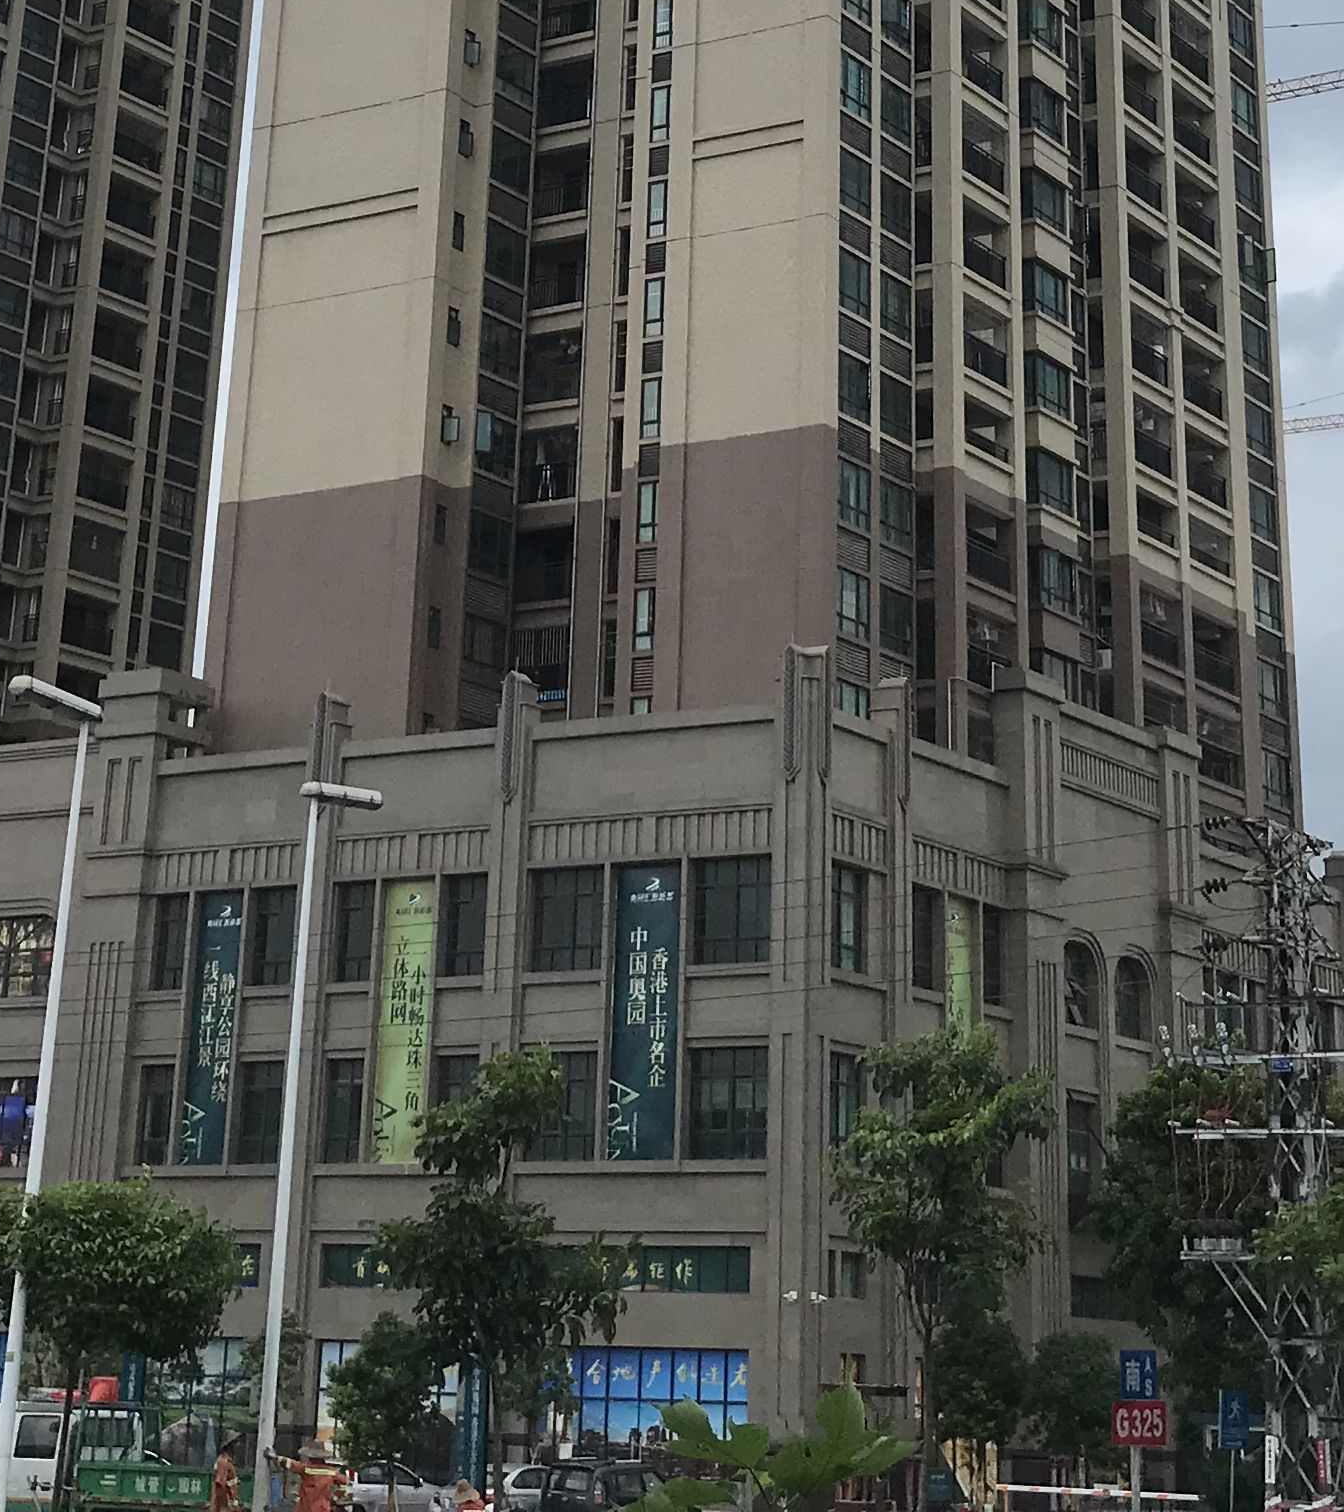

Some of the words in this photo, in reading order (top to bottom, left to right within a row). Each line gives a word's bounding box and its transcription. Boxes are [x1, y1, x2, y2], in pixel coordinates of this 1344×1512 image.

[390, 936, 410, 1024] 立体路网
[627, 926, 648, 1025] 中国奥园
[647, 947, 669, 1088] 香港上市名企
[210, 972, 235, 1102] 静享公园环绕
[405, 950, 428, 1112] 一小时畅达珠三角
[1116, 1408, 1163, 1438] G325
[1125, 1359, 1141, 1392] 南
